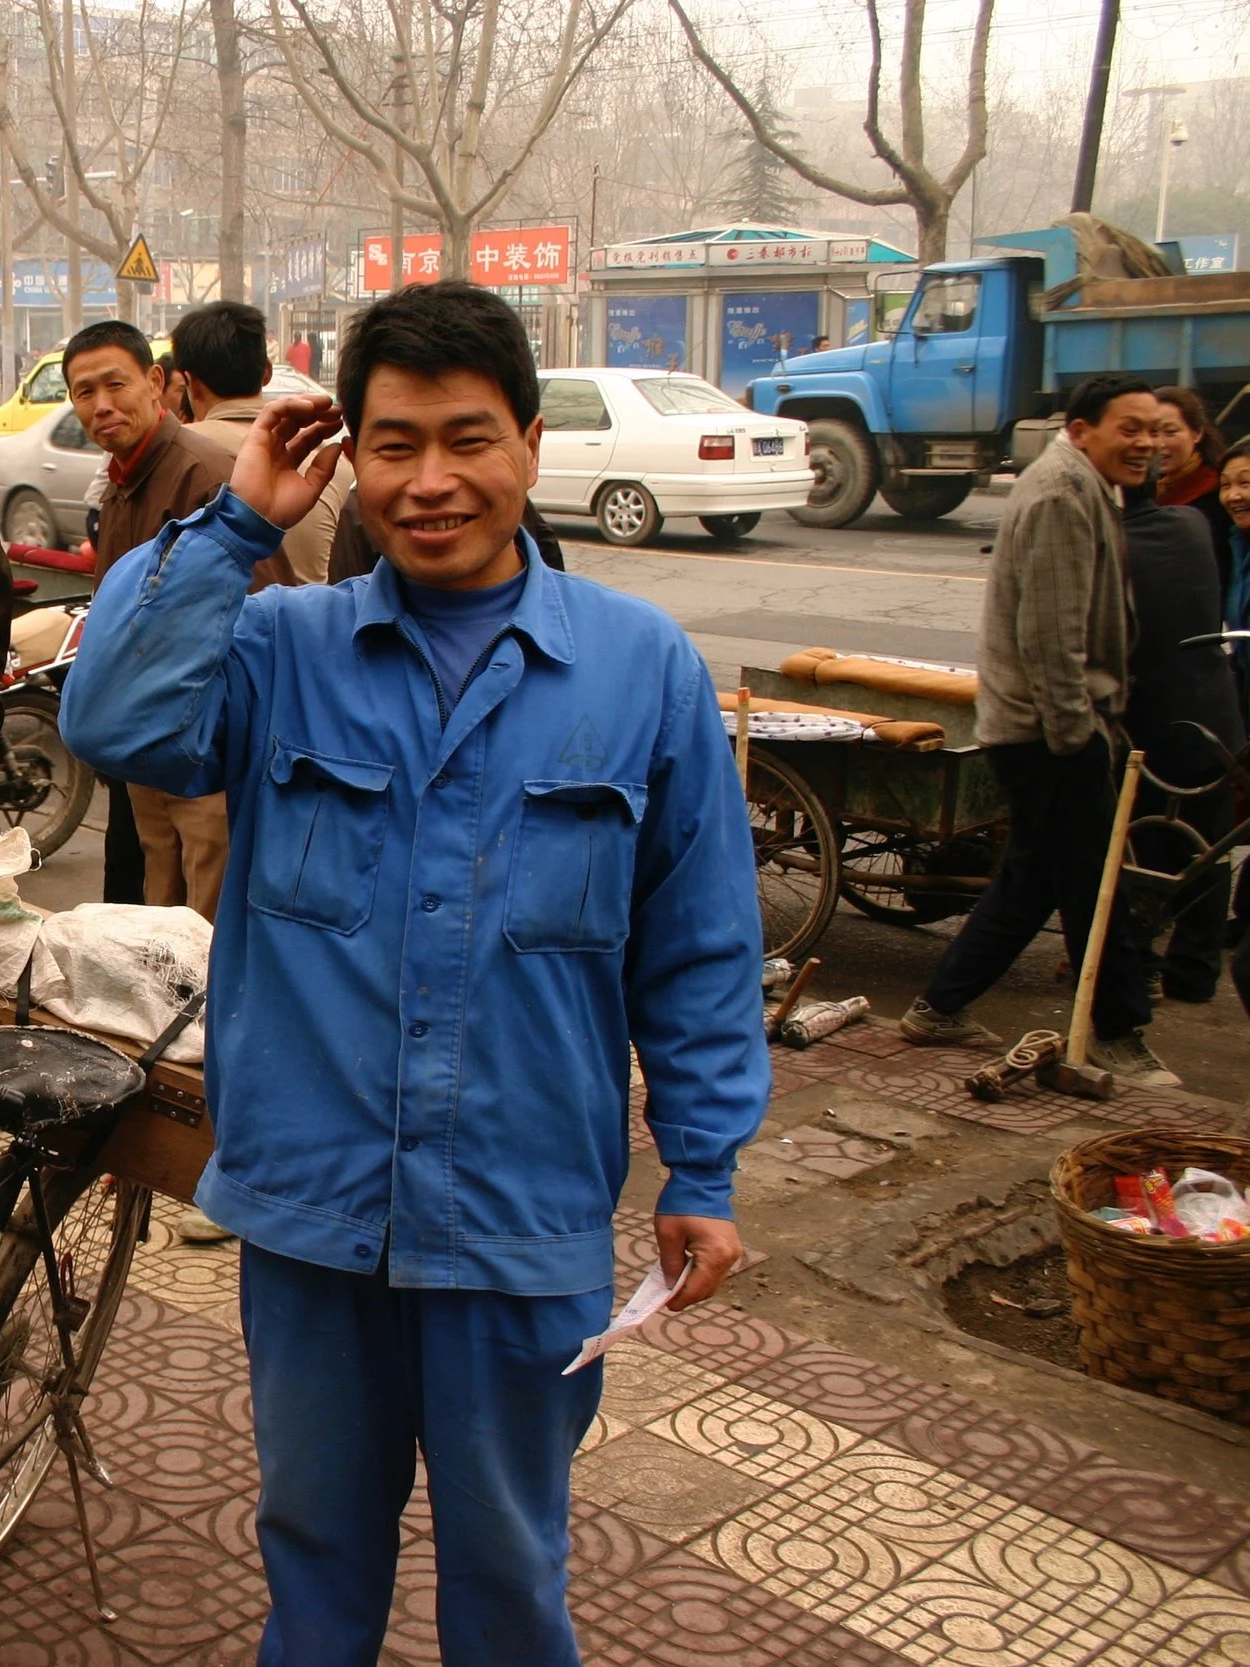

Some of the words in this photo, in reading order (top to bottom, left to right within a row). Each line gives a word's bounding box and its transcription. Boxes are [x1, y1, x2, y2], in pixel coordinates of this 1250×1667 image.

[401, 240, 562, 276] 南京中装饰
